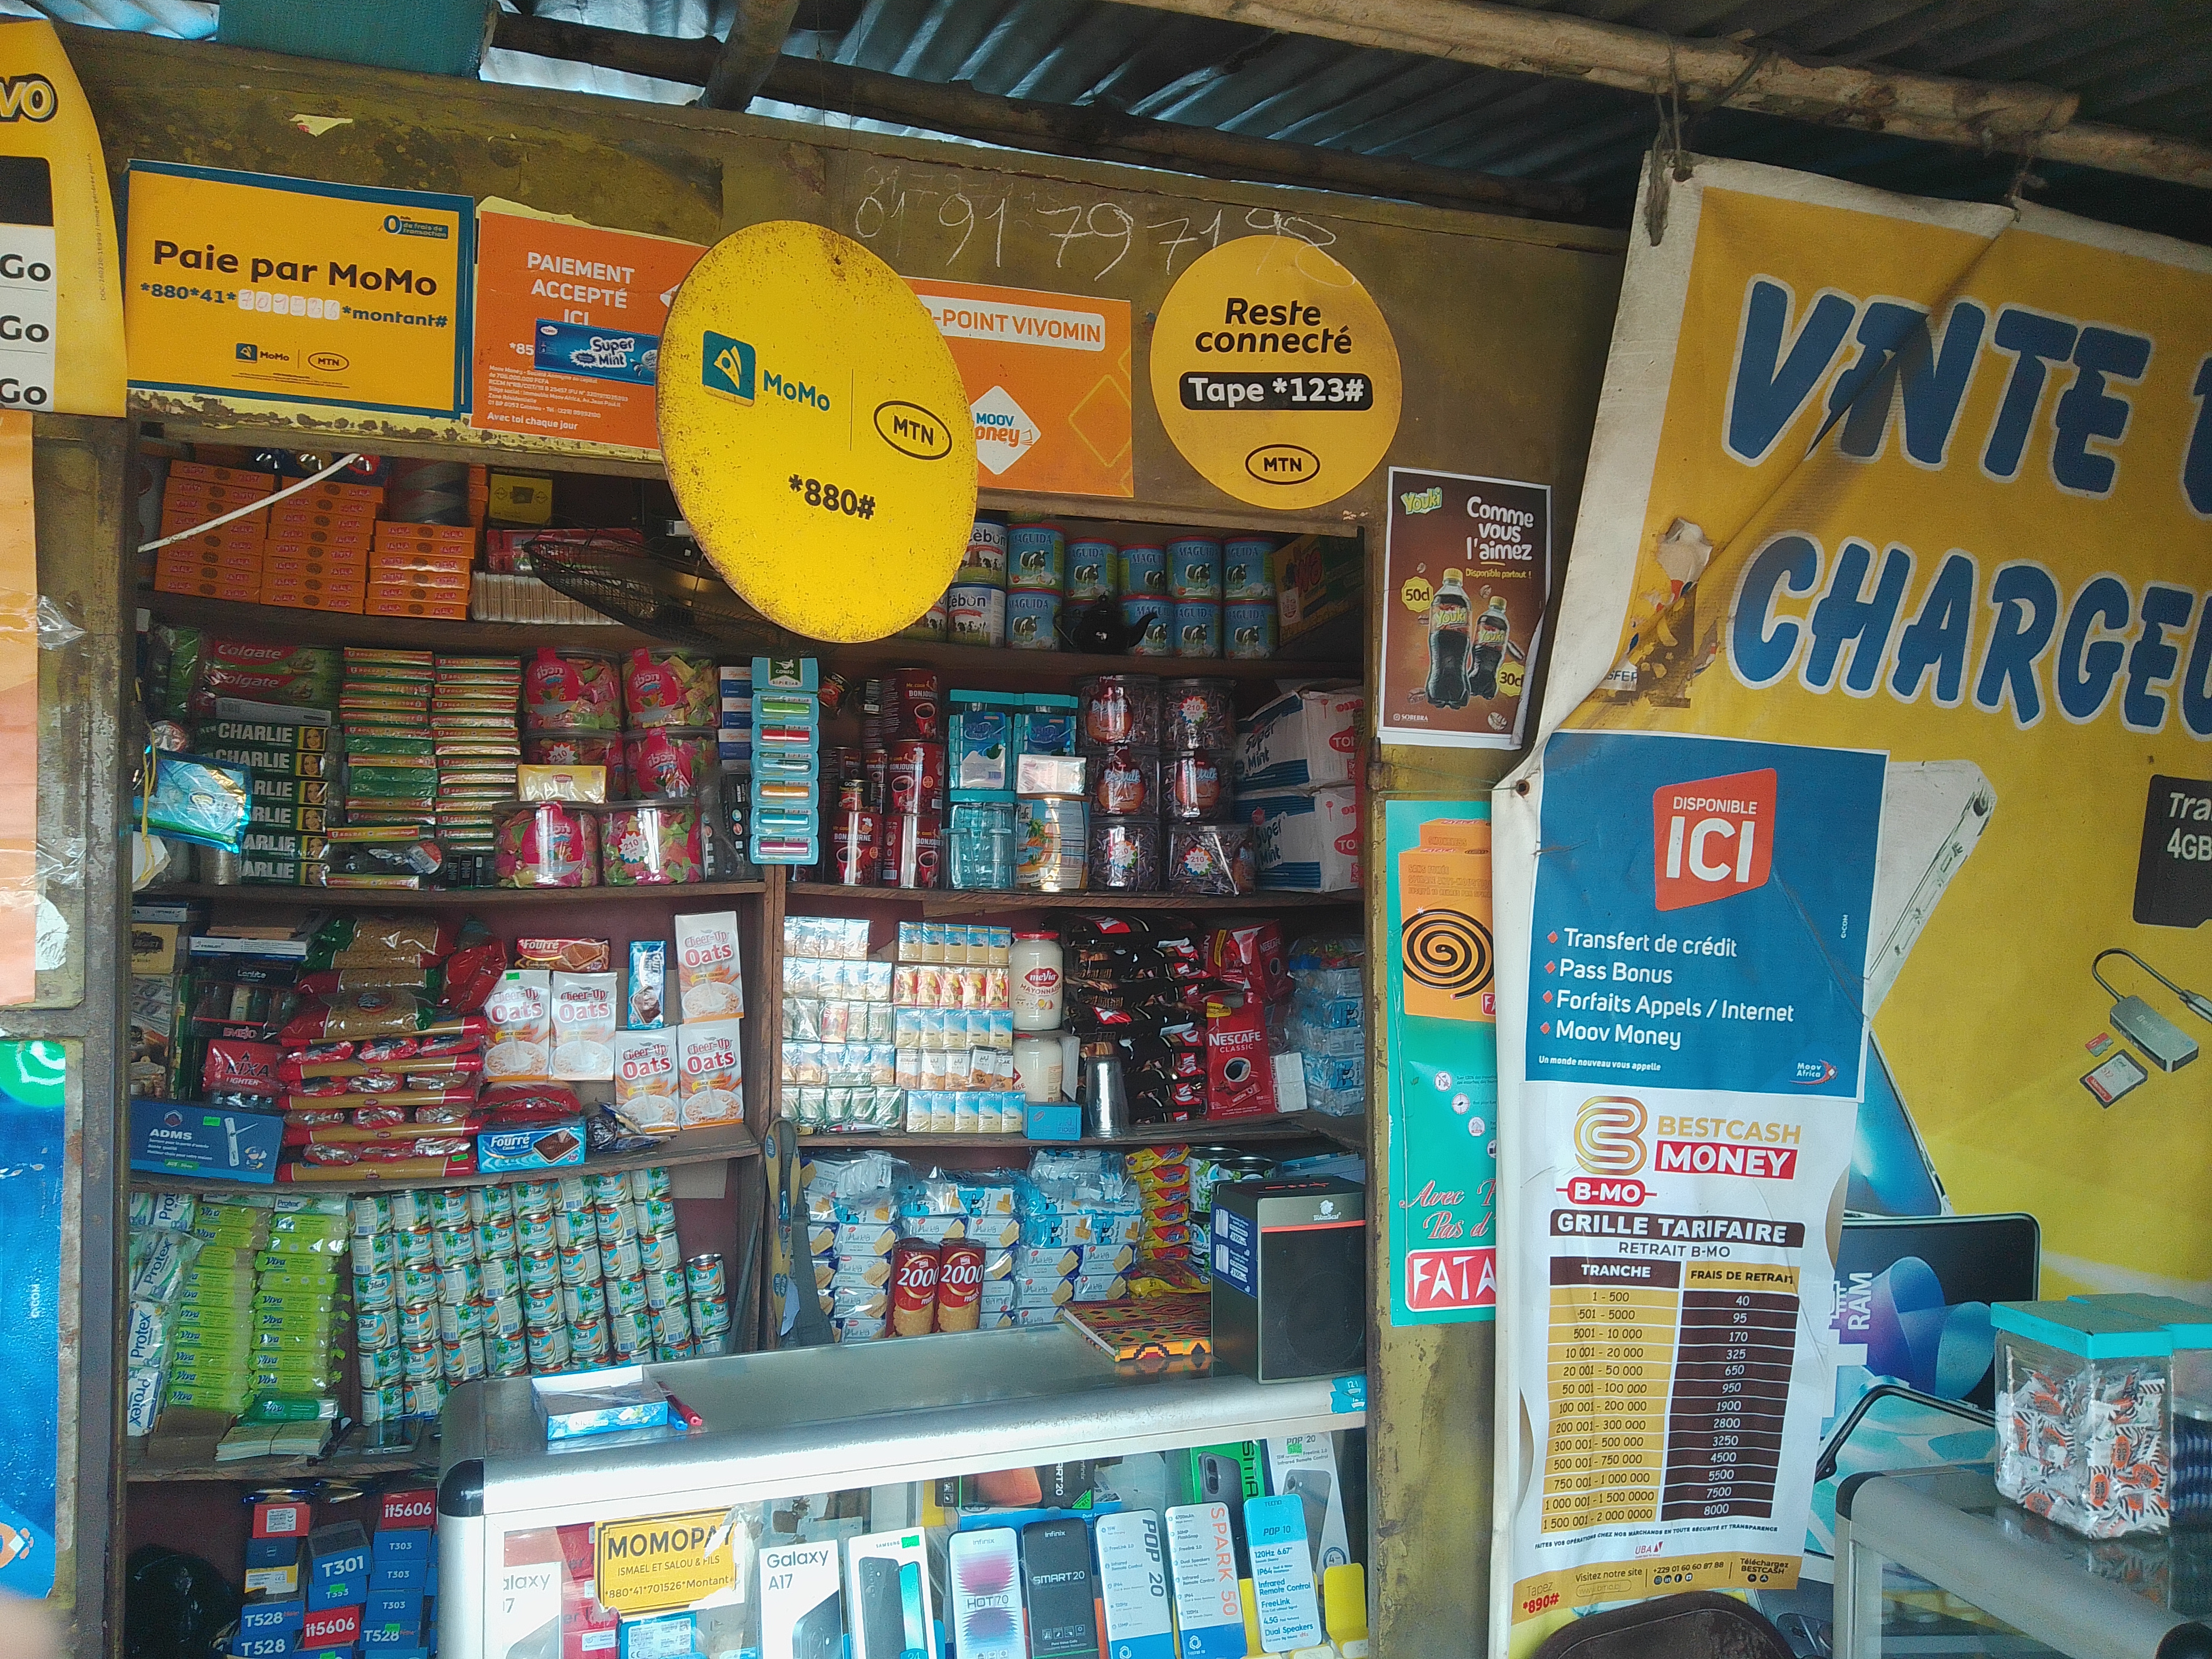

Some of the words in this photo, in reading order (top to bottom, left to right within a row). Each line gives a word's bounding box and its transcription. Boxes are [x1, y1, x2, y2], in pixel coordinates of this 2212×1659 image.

[939, 192, 1006, 267] 91
[1036, 202, 1135, 281] 79
[0, 254, 51, 283] Go
[153, 240, 239, 274] Paie
[250, 258, 318, 283] par
[328, 263, 438, 296] MoMo
[527, 252, 635, 284] PAIEMENT
[531, 279, 628, 308] ACCEPTÉ
[564, 308, 589, 326] ICI
[1226, 298, 1321, 325] Reste
[0, 315, 49, 343] Go
[925, 307, 1009, 332] -POINT
[1012, 316, 1100, 342] VIVOMIN
[593, 339, 633, 354] Super
[1196, 325, 1352, 355] connecté
[259, 351, 289, 361] MoMo
[317, 357, 339, 366] MTN
[598, 354, 624, 365] Mint
[0, 378, 47, 406] Go
[764, 370, 830, 411] MoMo
[1187, 378, 1264, 409] Tape
[487, 412, 510, 422] Avec
[512, 414, 523, 424] toi
[525, 417, 558, 428] chaque
[559, 421, 578, 430] jour
[976, 413, 1015, 426] MOOV
[893, 415, 933, 446] MTN
[975, 425, 1020, 448] oney
[1263, 457, 1302, 473] MTN
[1401, 488, 1442, 515] Youki
[1467, 496, 1534, 528] Comme
[1479, 522, 1521, 542] vous
[1467, 537, 1532, 561] l'aimez
[1465, 568, 1501, 578] Disponible
[1405, 588, 1430, 602] 50cl
[217, 643, 282, 659] Colgate
[219, 723, 292, 743] CHARLIE
[1673, 797, 1758, 815] DISPONIBLE
[1665, 816, 1755, 883] ICI
[2167, 827, 2212, 861] 4GB
[1564, 927, 1650, 951] Transfert
[1655, 934, 1677, 952] de
[1683, 936, 1737, 957] crédit
[684, 945, 733, 968] Oats
[1029, 973, 1056, 982] meVia
[1560, 958, 1606, 980] Pass
[1612, 962, 1673, 984] Bonus
[1020, 982, 1061, 996] MAYONNAISE
[1556, 990, 1631, 1013] Forfaits
[1636, 995, 1702, 1020] Appels
[1706, 999, 1717, 1018] /
[1722, 1000, 1794, 1023] Internet
[1556, 1019, 1610, 1042] Moov
[1615, 1024, 1681, 1050] Money
[1220, 1044, 1254, 1053] CLASSIC
[227, 1061, 269, 1077] KIXA
[1551, 1057, 1577, 1065] monde
[1632, 1061, 1661, 1072] appelle
[226, 1077, 259, 1086] LIGHTER
[149, 1128, 192, 1141] ADMS
[1658, 1116, 1802, 1144] BESTCASH
[490, 1134, 531, 1147] Fourré
[1661, 1144, 1791, 1177] MONEY
[1399, 1179, 1465, 1208] Avec
[1573, 1183, 1641, 1203] B-MO
[1423, 1210, 1464, 1239] Pas
[1557, 1213, 1649, 1235] GRILLE
[1658, 1218, 1787, 1244] TARIFAIRE
[1620, 1242, 1687, 1256] RETRAIT
[1691, 1246, 1730, 1258] B-MO
[941, 1263, 983, 1284] 2000
[1581, 1264, 1651, 1277] TRANCHE
[1690, 1270, 1722, 1280] FRAIS
[1727, 1271, 1741, 1281] DE
[1746, 1272, 1794, 1284] RETRAIT
[1593, 1292, 1597, 1301] 1
[1609, 1292, 1629, 1302] 500
[1736, 1296, 1749, 1305] 40
[1848, 1271, 1873, 1330] RAM
[1733, 1313, 1747, 1323] 95
[131, 1312, 152, 1358] Protex
[1729, 1333, 1748, 1342] 170
[1726, 1350, 1746, 1359] 325
[171, 1391, 192, 1402] Viva
[1716, 1401, 1741, 1412] 1900
[1713, 1418, 1740, 1429] 2800
[1712, 1436, 1739, 1447] 3250
[1708, 1470, 1734, 1480] 5500
[1706, 1487, 1732, 1498] 7500
[384, 1503, 432, 1518] it5606
[1704, 1504, 1729, 1515] 8000
[1263, 1526, 1280, 1537] POP
[1282, 1526, 1291, 1534] 10
[389, 1542, 412, 1551] T303
[1142, 1520, 1159, 1562] POP
[1210, 1507, 1234, 1582] SPARK
[1635, 1545, 1652, 1554] UBA
[767, 1549, 828, 1568] Galaxy
[1254, 1550, 1275, 1559] 120Hz
[1740, 1558, 1789, 1568] Téléchargez
[322, 1556, 364, 1576] T301
[618, 1564, 649, 1576] ISMAEL
[652, 1563, 662, 1572] ET
[664, 1559, 694, 1571] SALOU
[703, 1555, 720, 1565] FILS
[1576, 1571, 1602, 1582] Visitez
[1603, 1570, 1626, 1579] notre
[1628, 1567, 1643, 1576] site
[1741, 1565, 1784, 1574] BESTCASH
[768, 1574, 793, 1590] A17
[1148, 1572, 1164, 1597] 20
[1527, 1581, 1553, 1597] Tapez
[1221, 1590, 1238, 1616] 50
[241, 1640, 285, 1656] T528
